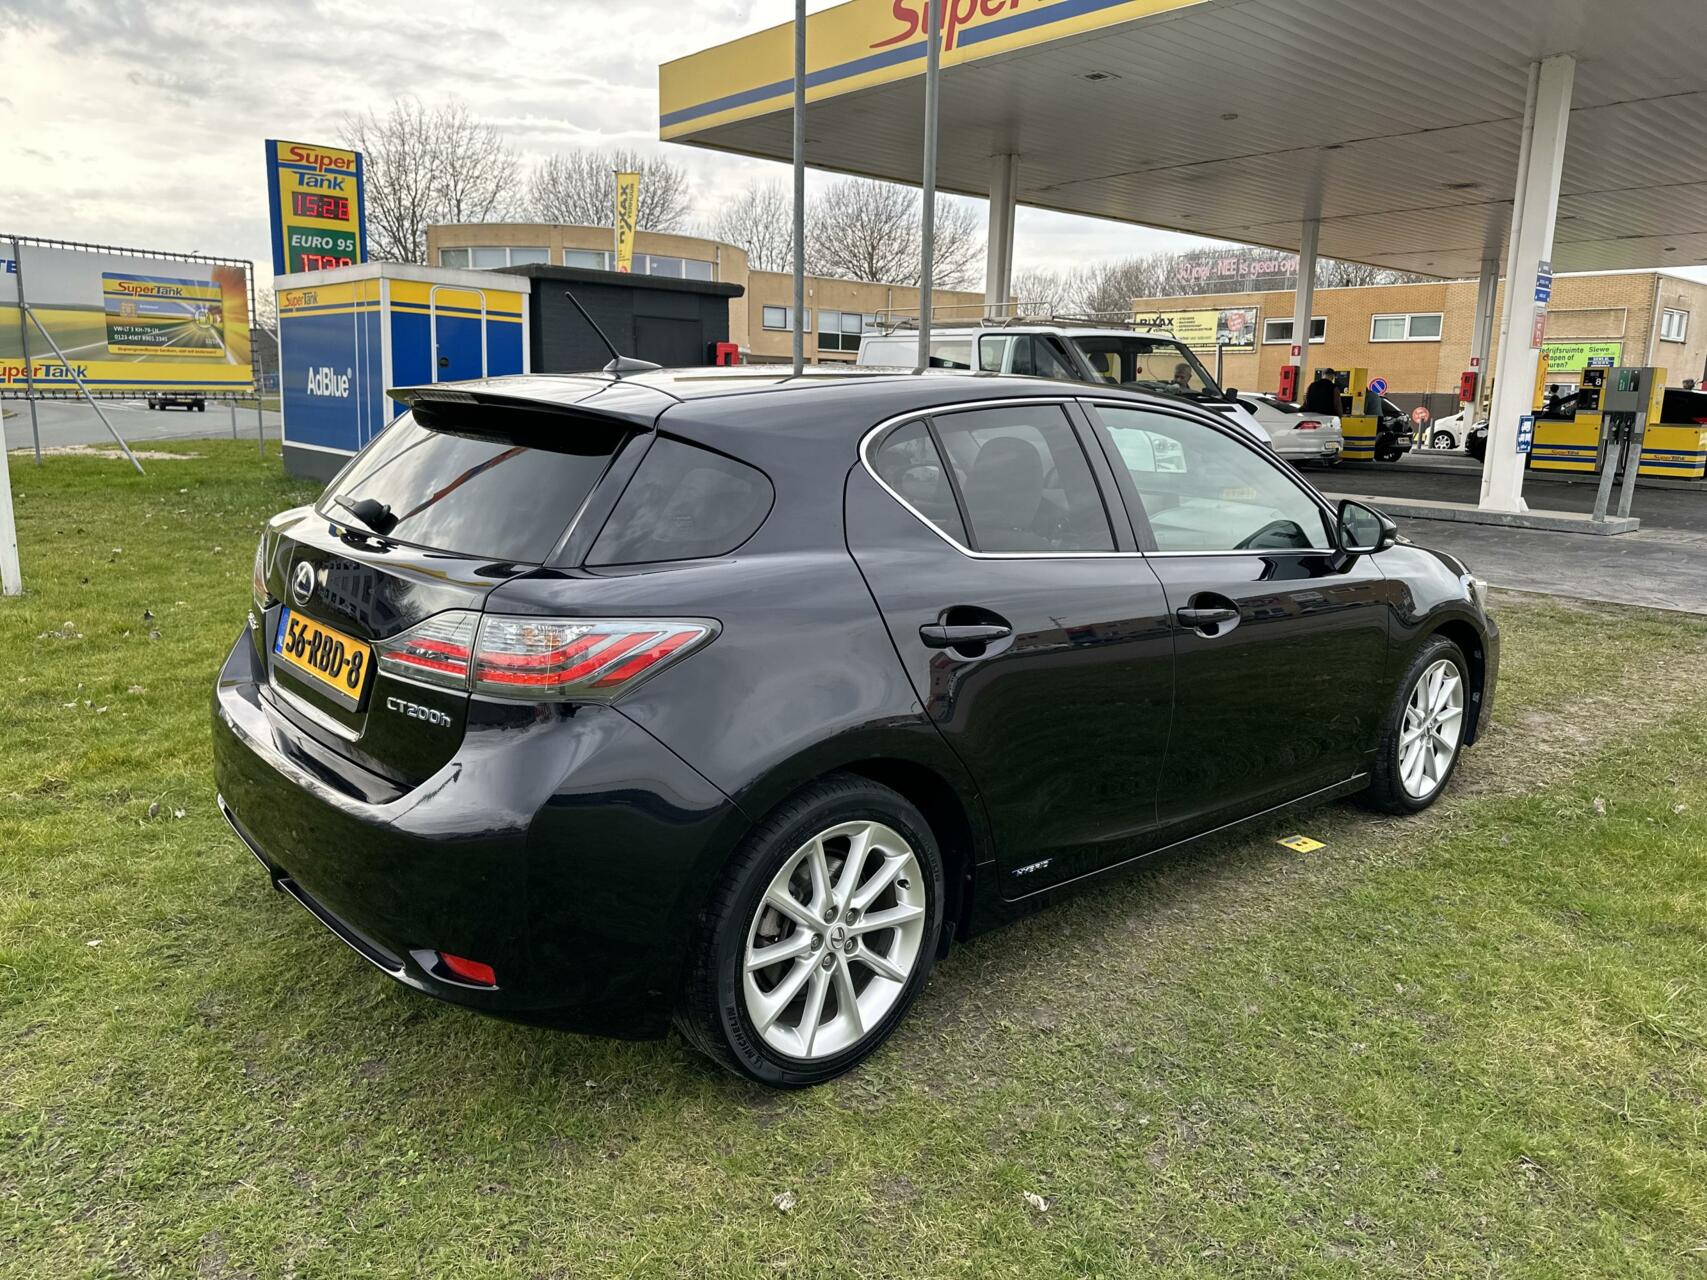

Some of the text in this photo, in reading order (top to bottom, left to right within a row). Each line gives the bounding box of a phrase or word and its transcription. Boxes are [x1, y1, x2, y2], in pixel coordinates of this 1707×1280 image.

[279, 146, 355, 172] Super
[291, 171, 345, 191] Tank
[291, 234, 354, 251] EURO 95
[112, 281, 182, 297] SuperTank
[283, 291, 318, 308] SuperTank
[1595, 378, 1602, 386] 8
[285, 618, 364, 689] 56-RBD-8
[386, 696, 451, 728] CT200h
